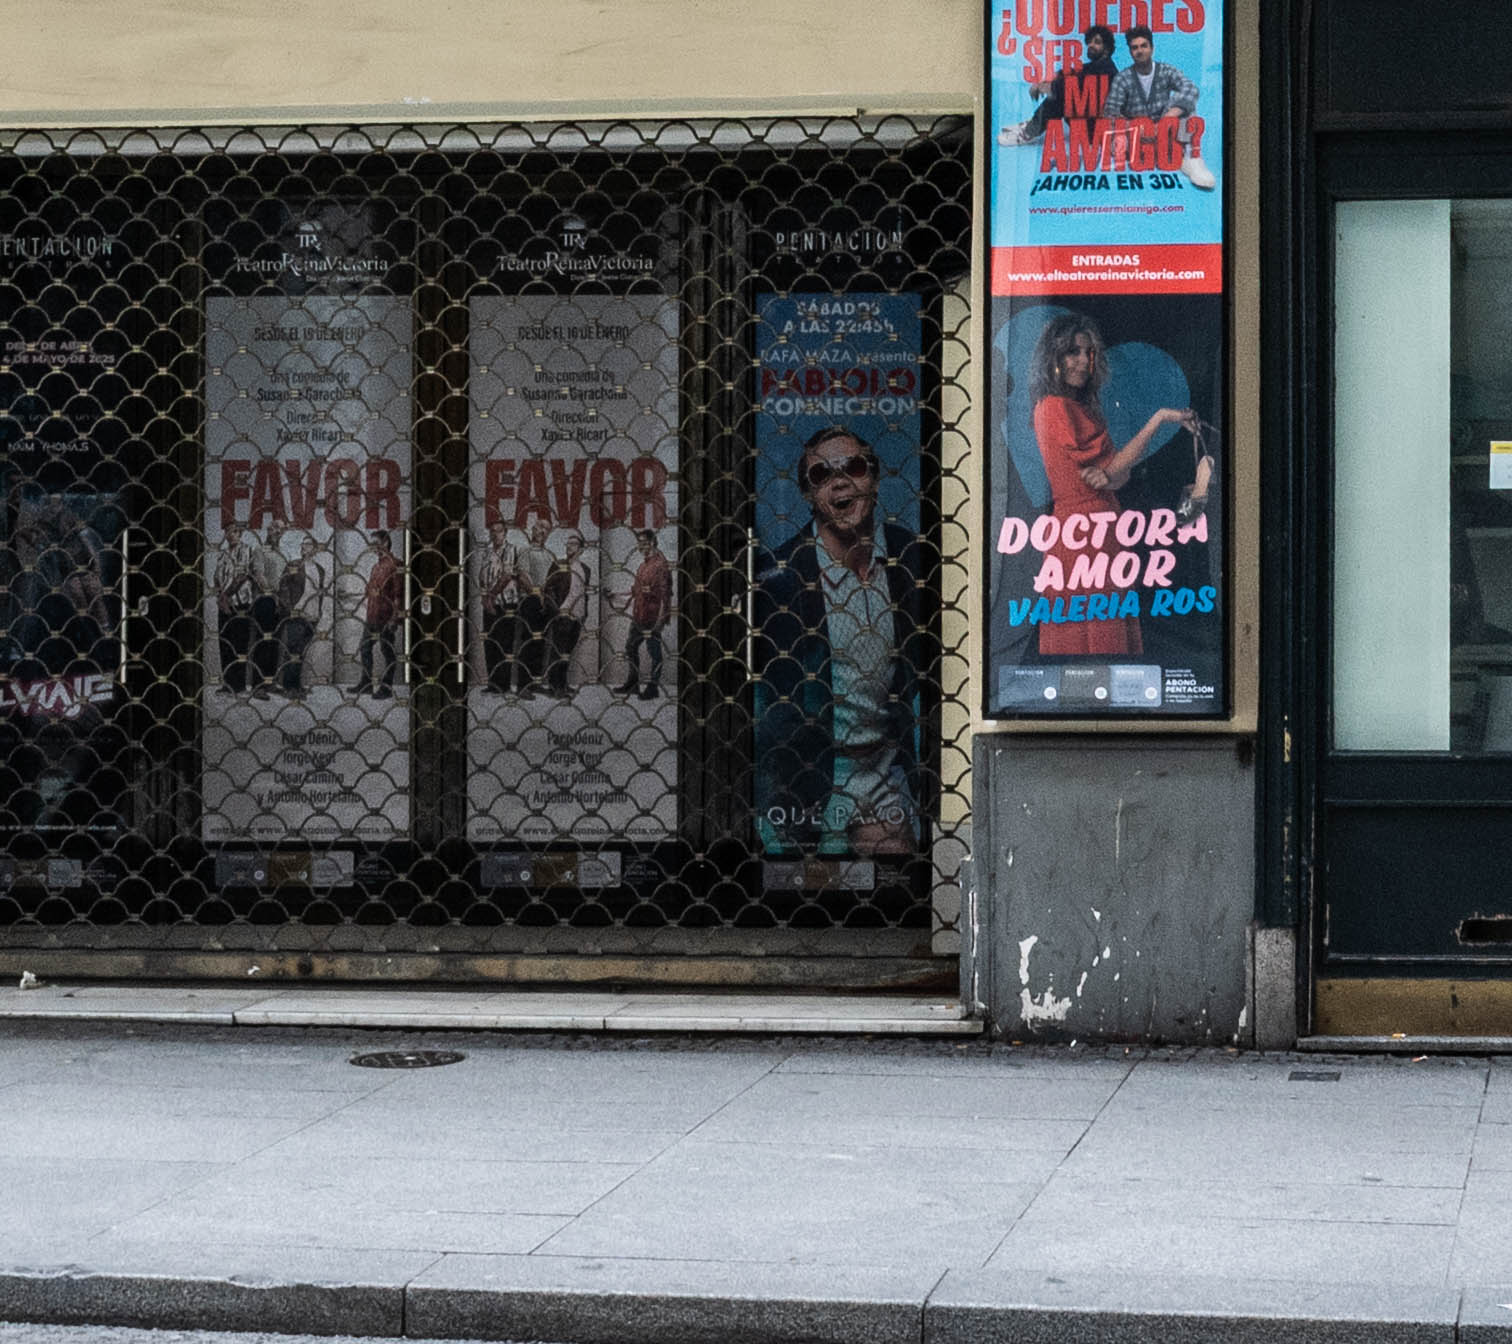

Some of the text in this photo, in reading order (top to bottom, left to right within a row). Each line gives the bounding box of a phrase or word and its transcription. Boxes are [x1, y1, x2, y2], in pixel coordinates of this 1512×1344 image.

[1022, 36, 1083, 83] SER
[1063, 74, 1110, 117] MI
[1039, 116, 1205, 173] AMIGO?
[1030, 173, 1184, 196] ¡AHORA EN 3D!
[776, 231, 904, 252] PENTACION
[1071, 254, 1140, 267] ENTRADAS
[1007, 269, 1205, 283] www.elteatroreinavictoria.com
[761, 367, 916, 397] FABIOLO
[220, 459, 401, 530] FAVOR
[484, 458, 668, 530] FAVOR
[996, 508, 1209, 555] DOCTORA
[1033, 549, 1177, 593] AMOR
[1008, 585, 1218, 627] VALERIA ROS
